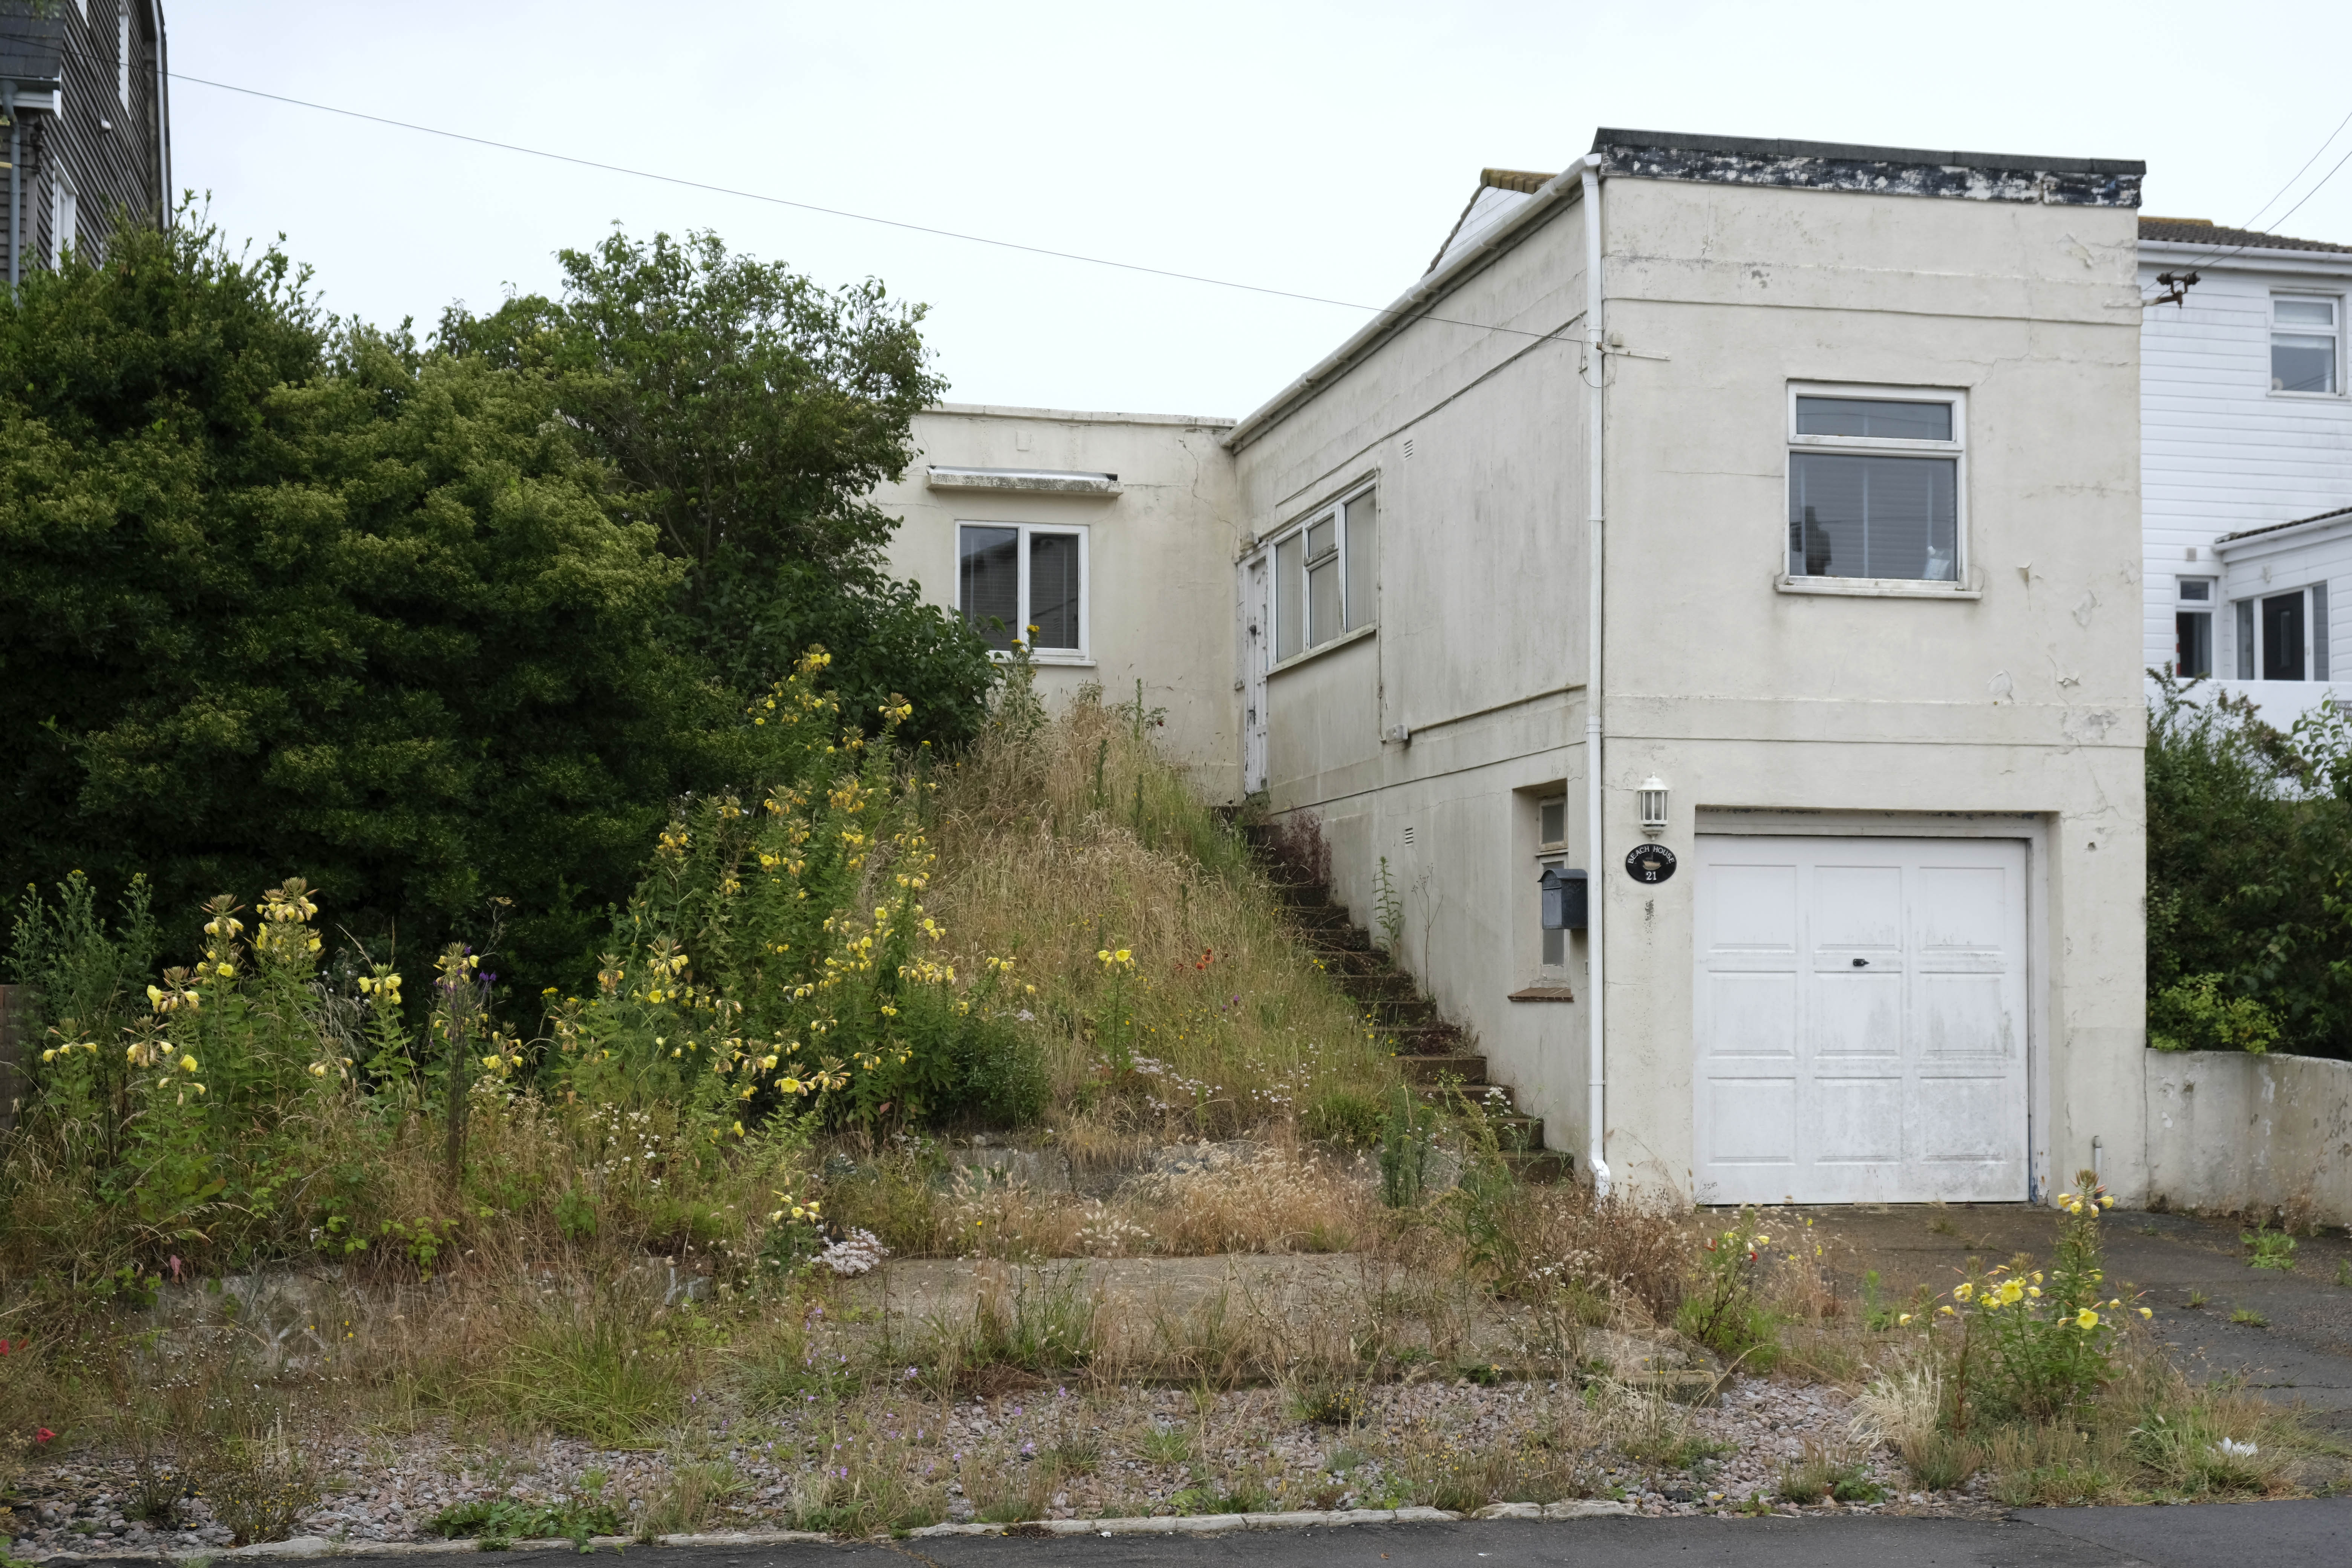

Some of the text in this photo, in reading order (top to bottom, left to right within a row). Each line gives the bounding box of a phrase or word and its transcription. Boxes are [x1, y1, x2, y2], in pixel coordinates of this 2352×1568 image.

[1628, 846, 1675, 864] BEACH HOUSE
[1646, 871, 1657, 880] 21
